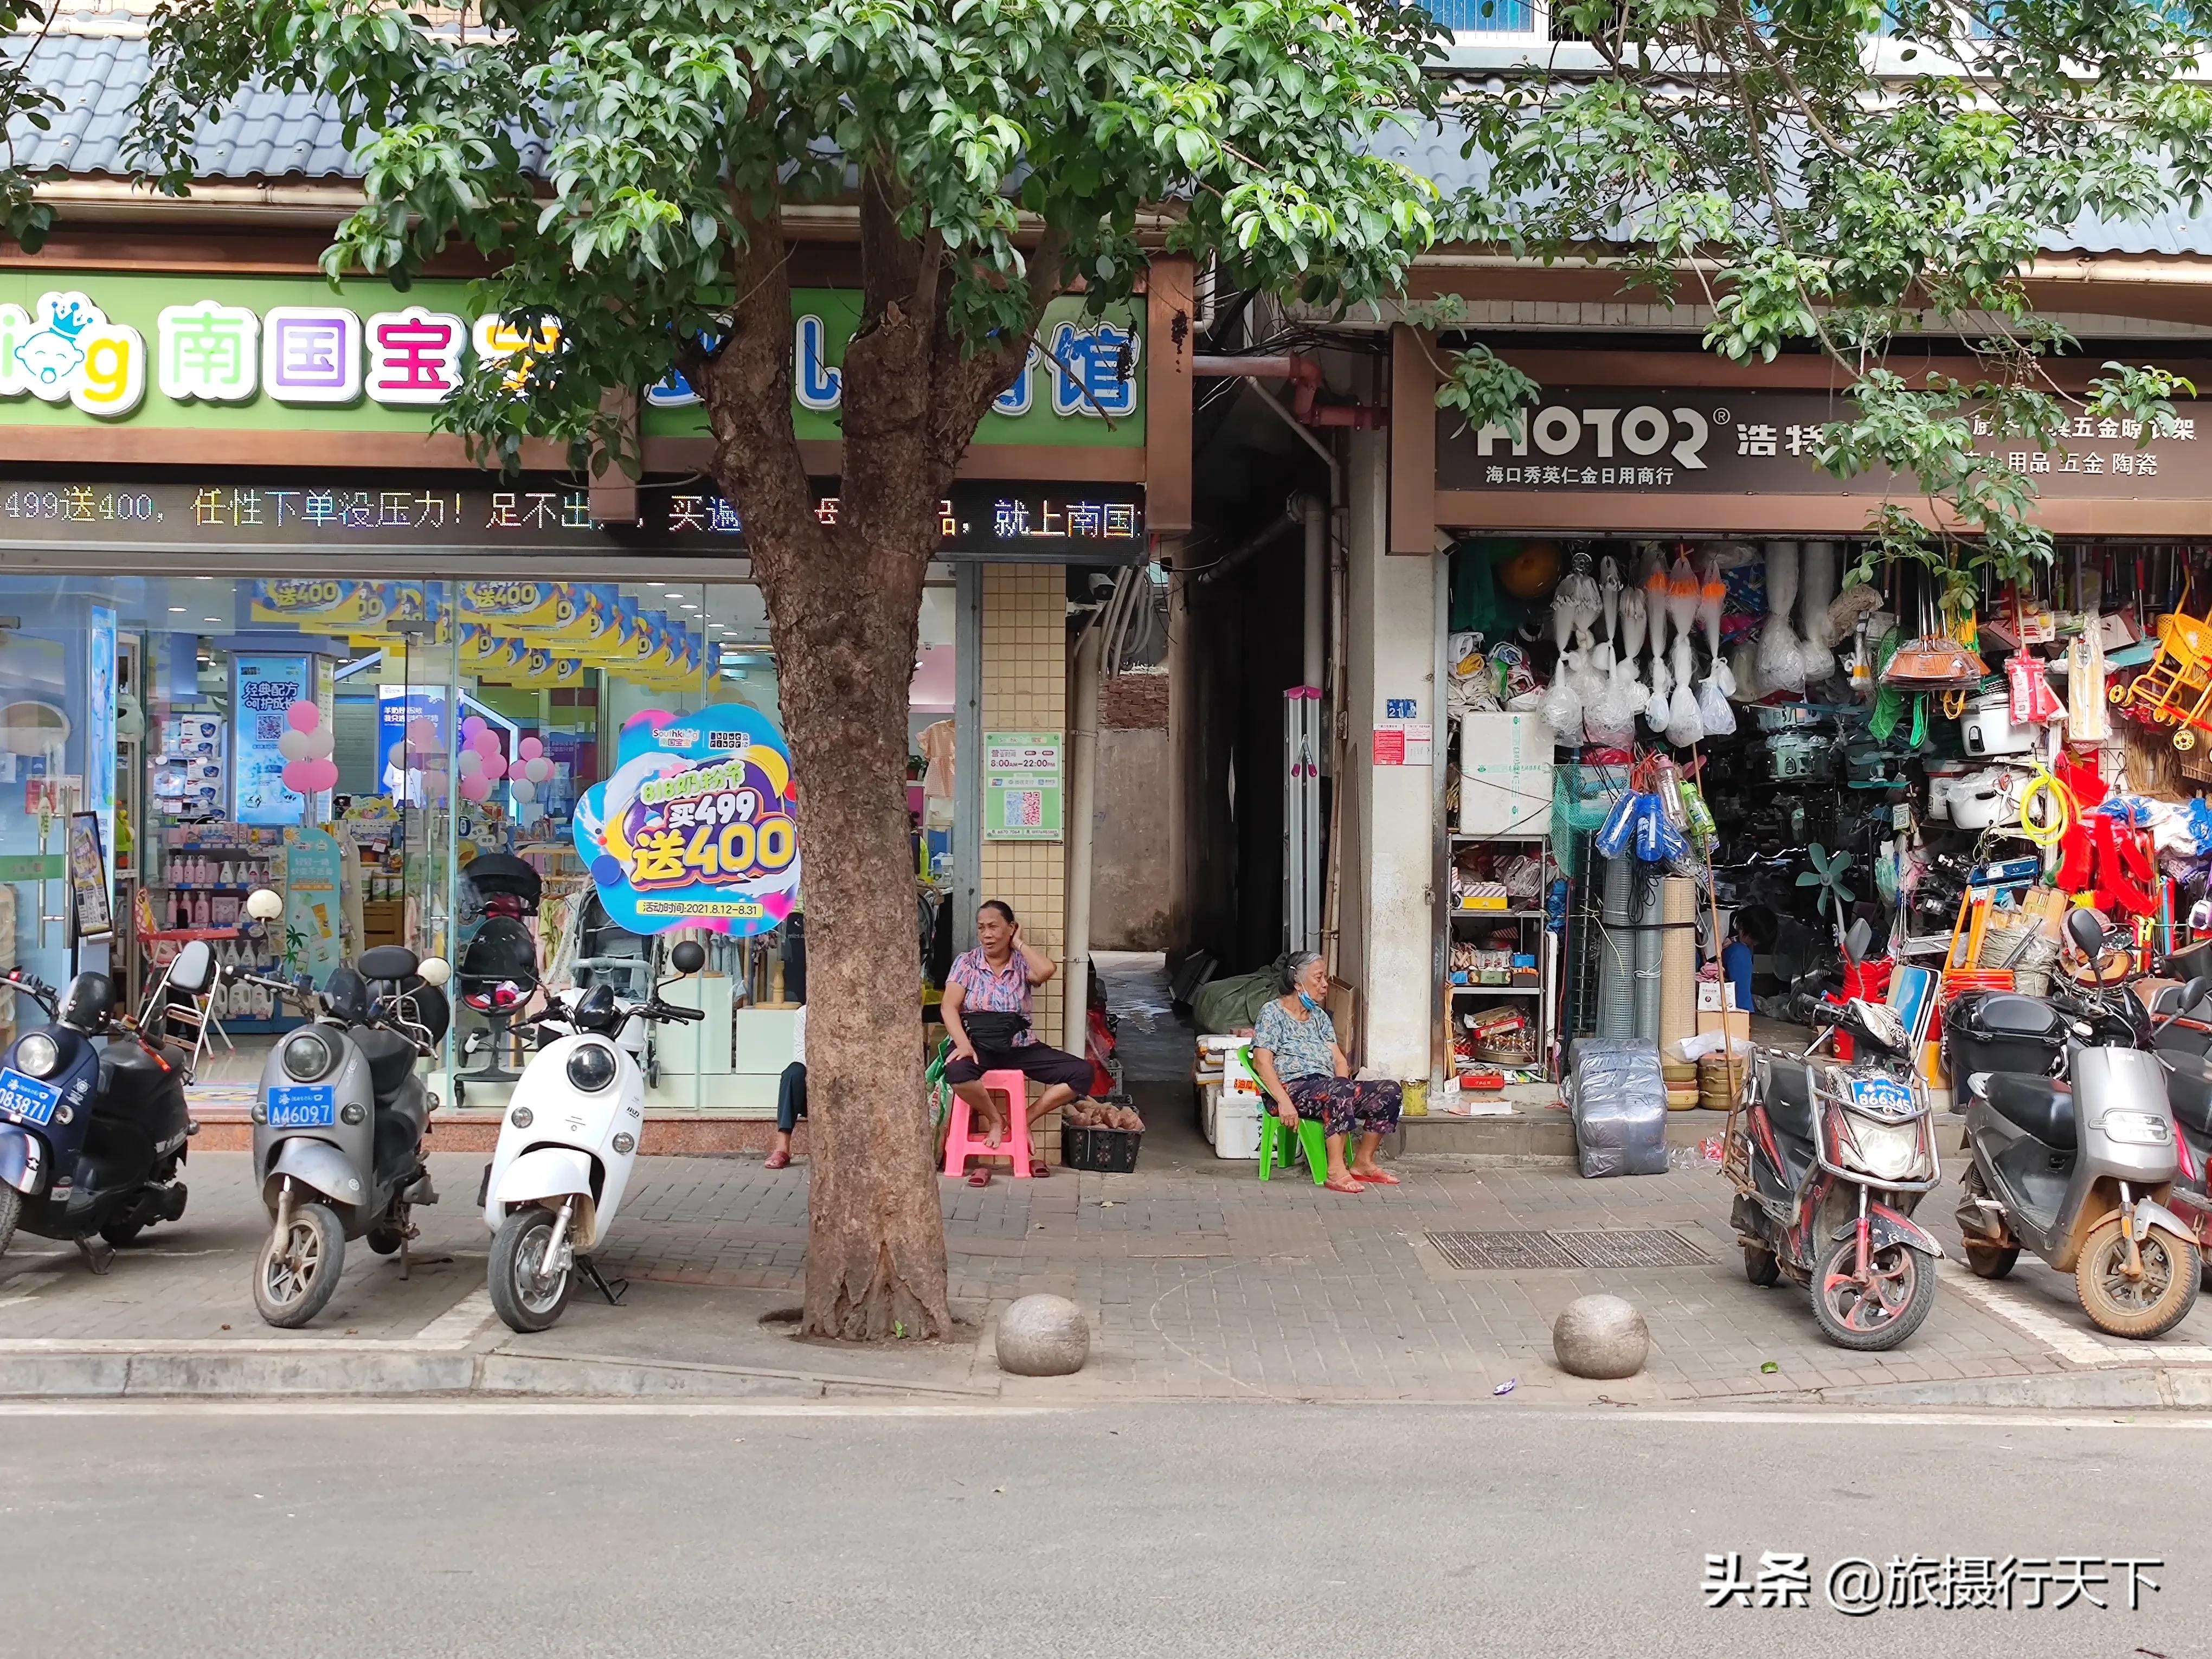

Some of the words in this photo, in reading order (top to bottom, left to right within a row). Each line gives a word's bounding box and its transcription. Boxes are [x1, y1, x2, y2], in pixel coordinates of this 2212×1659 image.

[1486, 465, 1674, 486] 海口秀英仁金日用商行
[2112, 452, 2158, 477] 陶瓷
[242, 681, 299, 699] 经典配方
[643, 761, 744, 802] 818奶粉节
[669, 791, 755, 829] 买499
[630, 818, 795, 883] 送400
[1859, 1092, 1912, 1112] 866345
[272, 1105, 330, 1123] A46097
